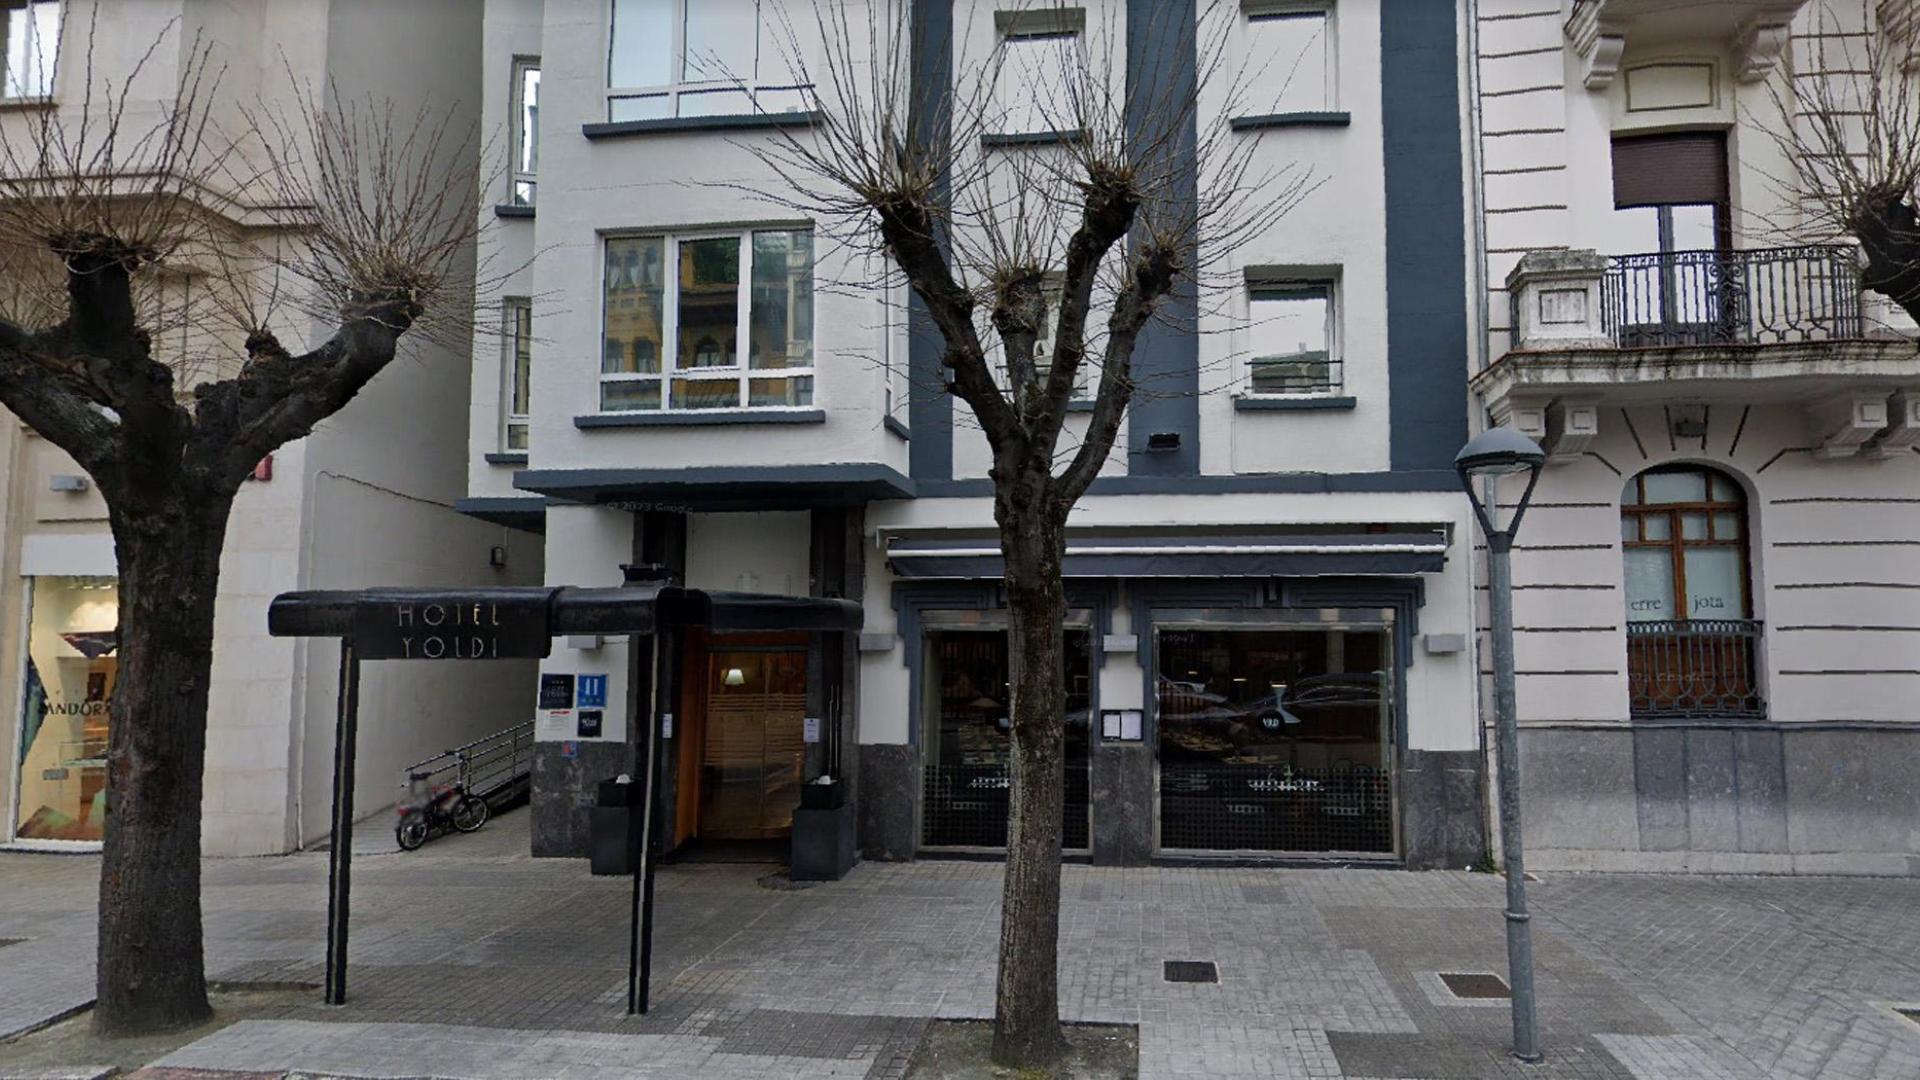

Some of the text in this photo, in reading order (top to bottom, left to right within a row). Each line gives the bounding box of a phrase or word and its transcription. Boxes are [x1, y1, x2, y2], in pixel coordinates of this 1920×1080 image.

[1630, 595, 1725, 613] erre jota
[397, 602, 500, 627] HOTEL
[401, 635, 498, 658] YOLDI
[41, 701, 111, 716] ANDOR
